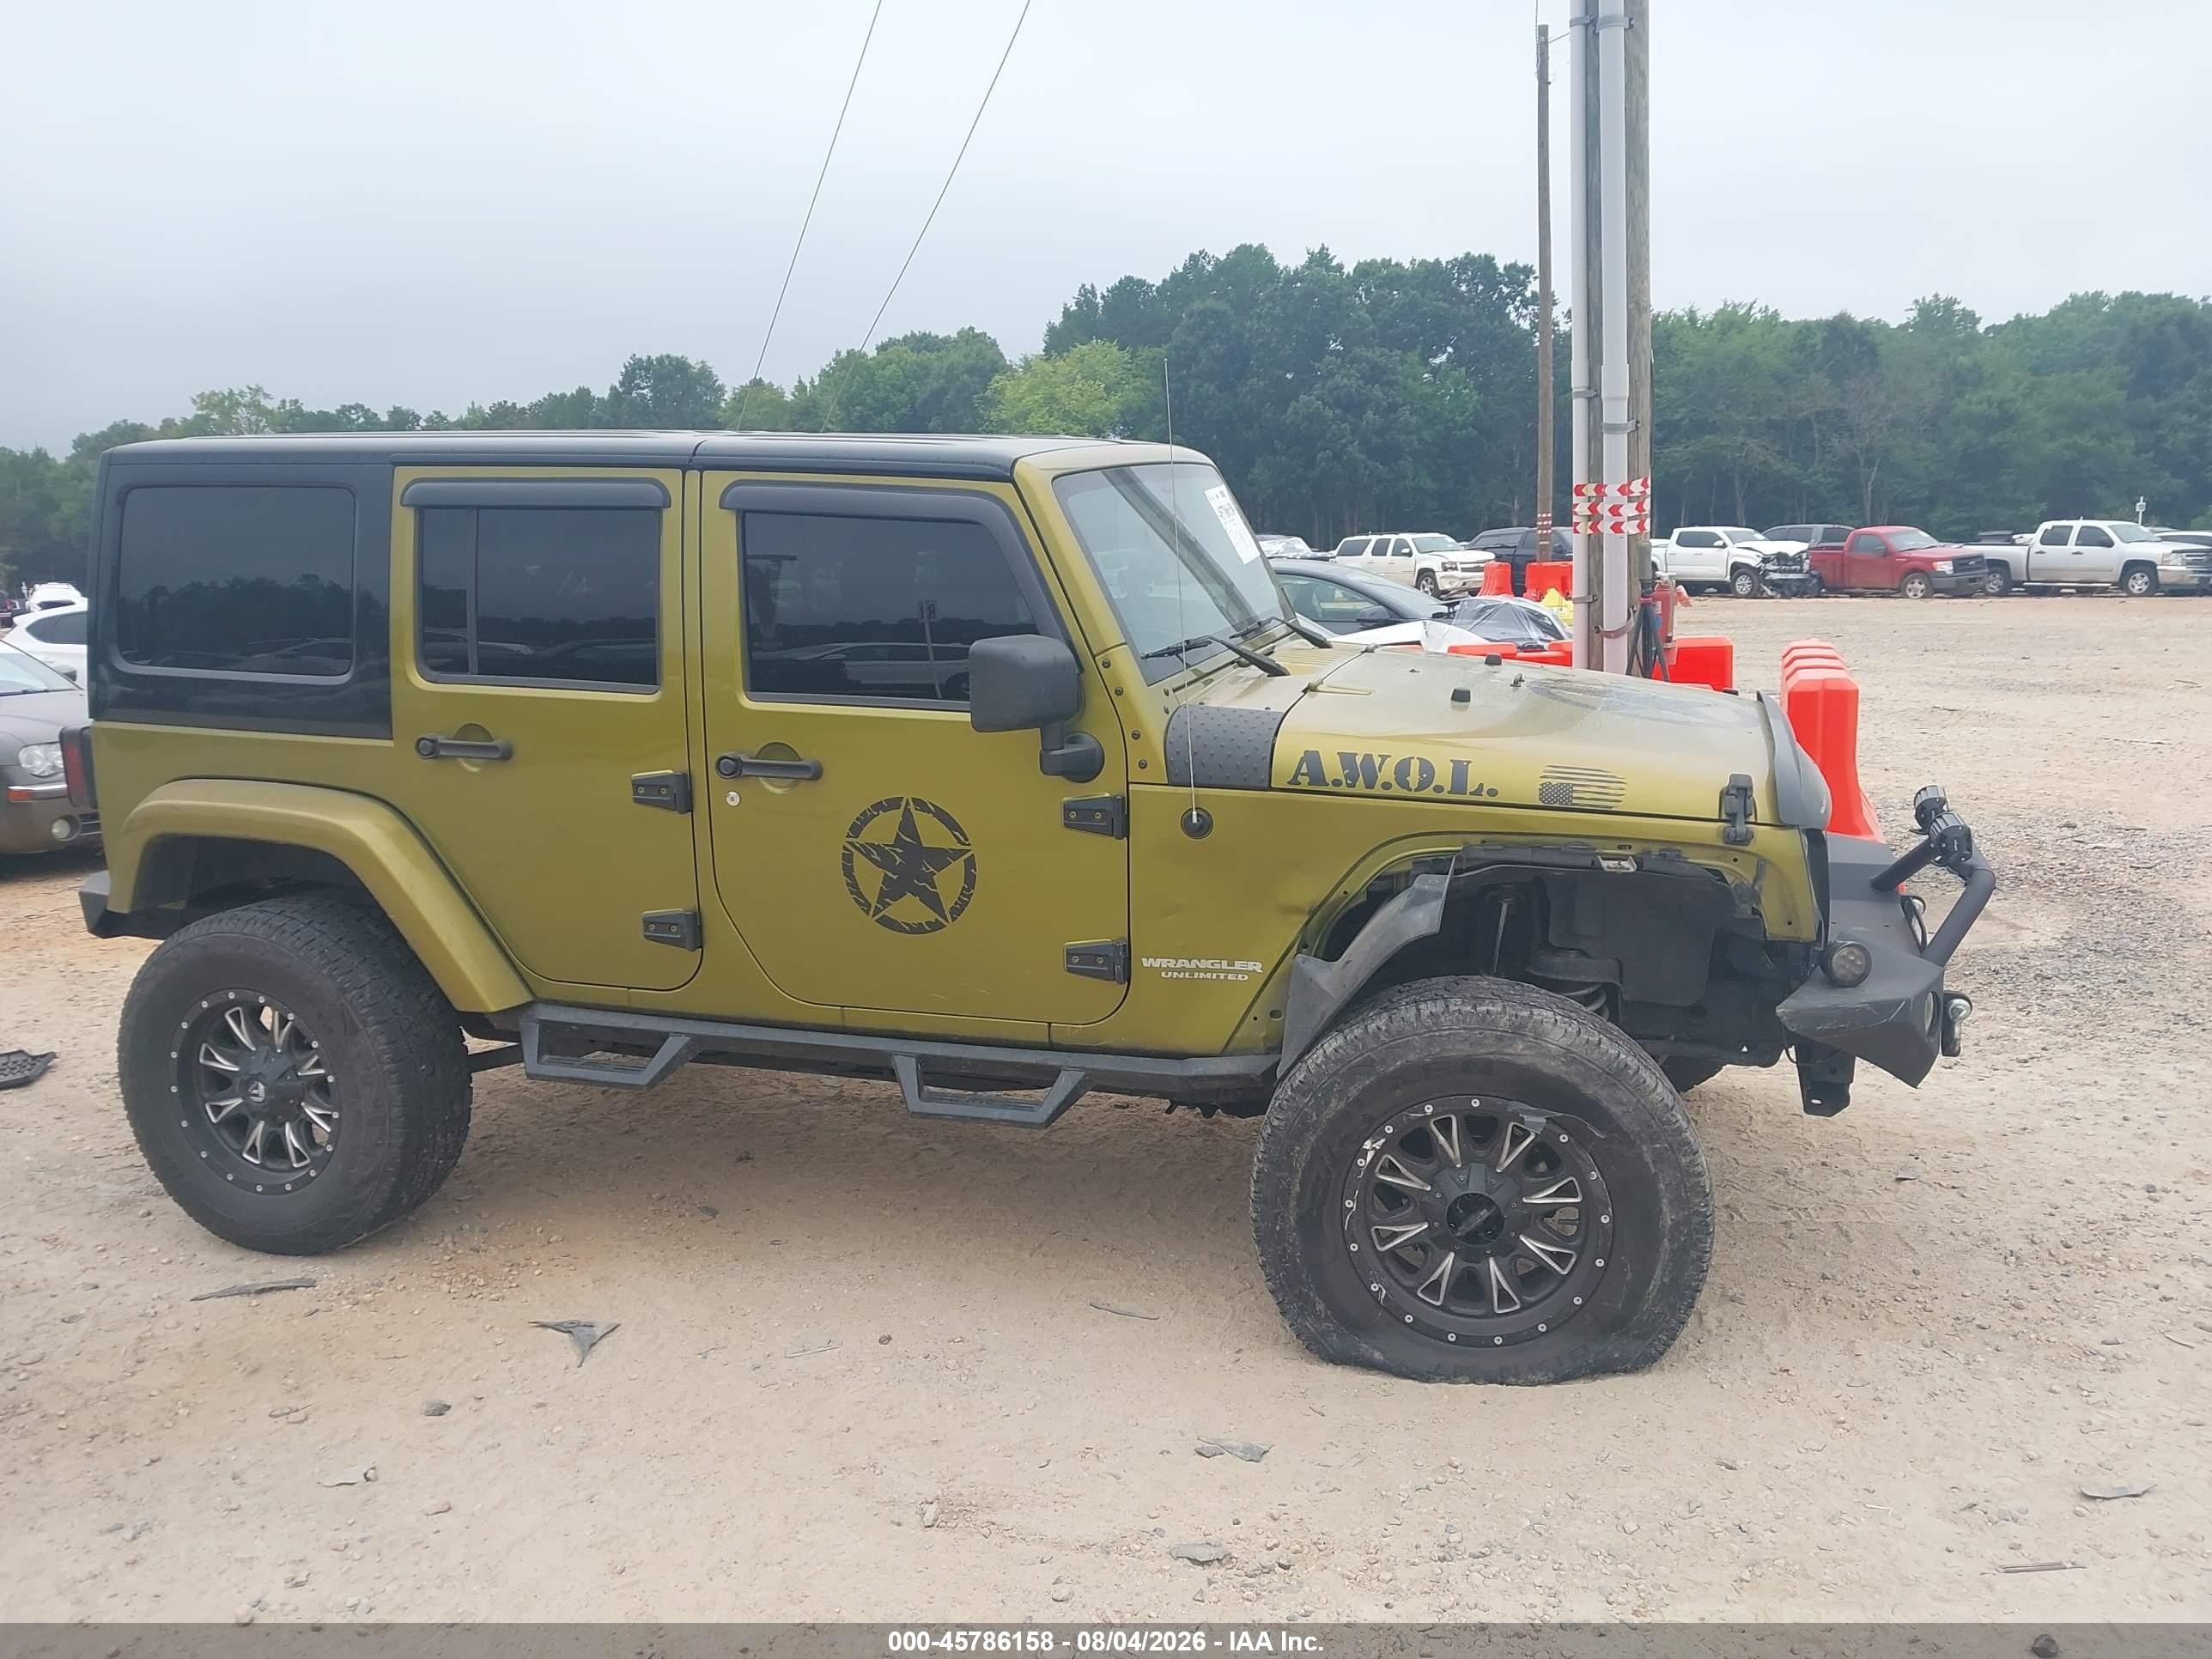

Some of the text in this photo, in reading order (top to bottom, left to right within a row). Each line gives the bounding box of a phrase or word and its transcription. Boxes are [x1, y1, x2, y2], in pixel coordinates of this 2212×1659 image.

[1286, 749, 1499, 798] A.W.O.L.
[1140, 957, 1264, 973] WRANGLER
[1160, 971, 1249, 981] UNLIMITED
